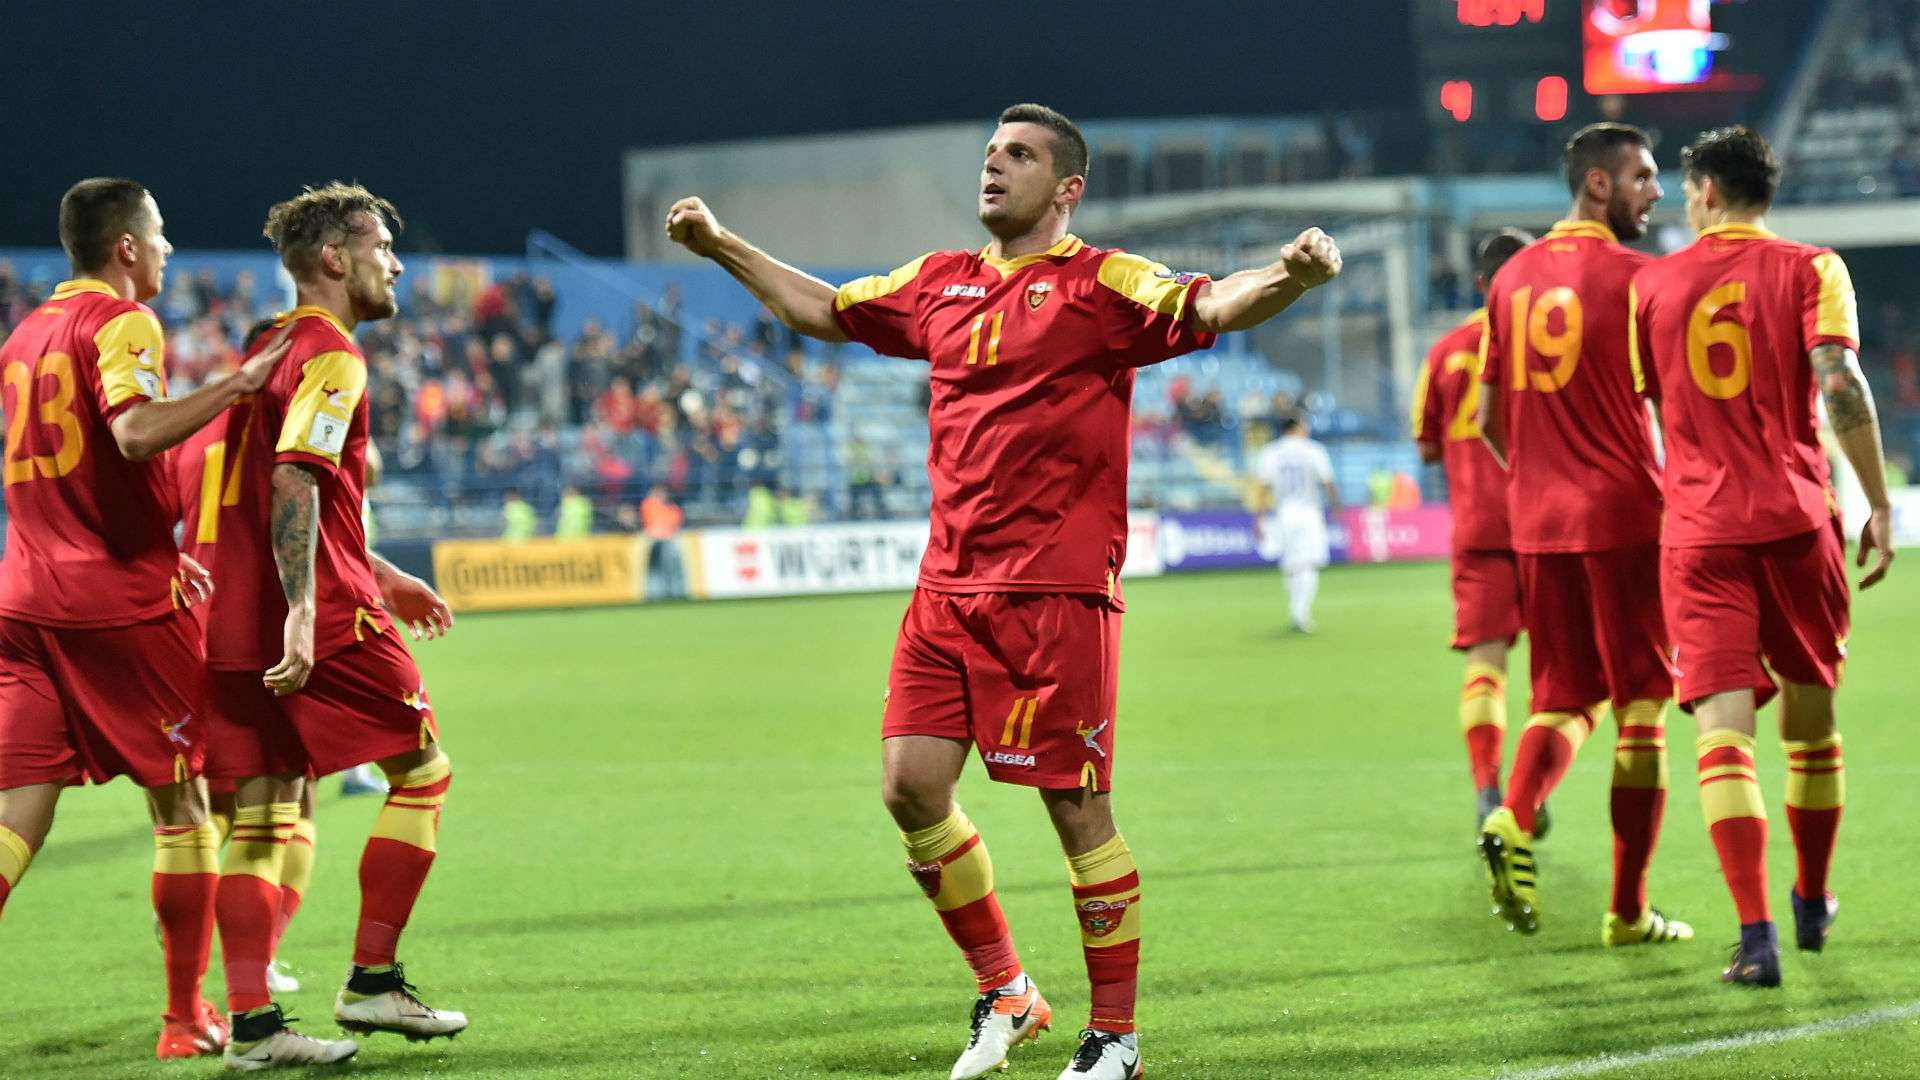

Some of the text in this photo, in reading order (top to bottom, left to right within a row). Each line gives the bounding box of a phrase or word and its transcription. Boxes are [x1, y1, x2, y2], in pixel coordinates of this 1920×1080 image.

[966, 310, 1005, 366] 11
[1509, 285, 1584, 393] 19
[1687, 281, 1751, 400] 6
[1, 352, 85, 486] 23
[452, 555, 605, 597] Continental
[999, 697, 1040, 750] 11
[984, 751, 1036, 767] LEGEA
